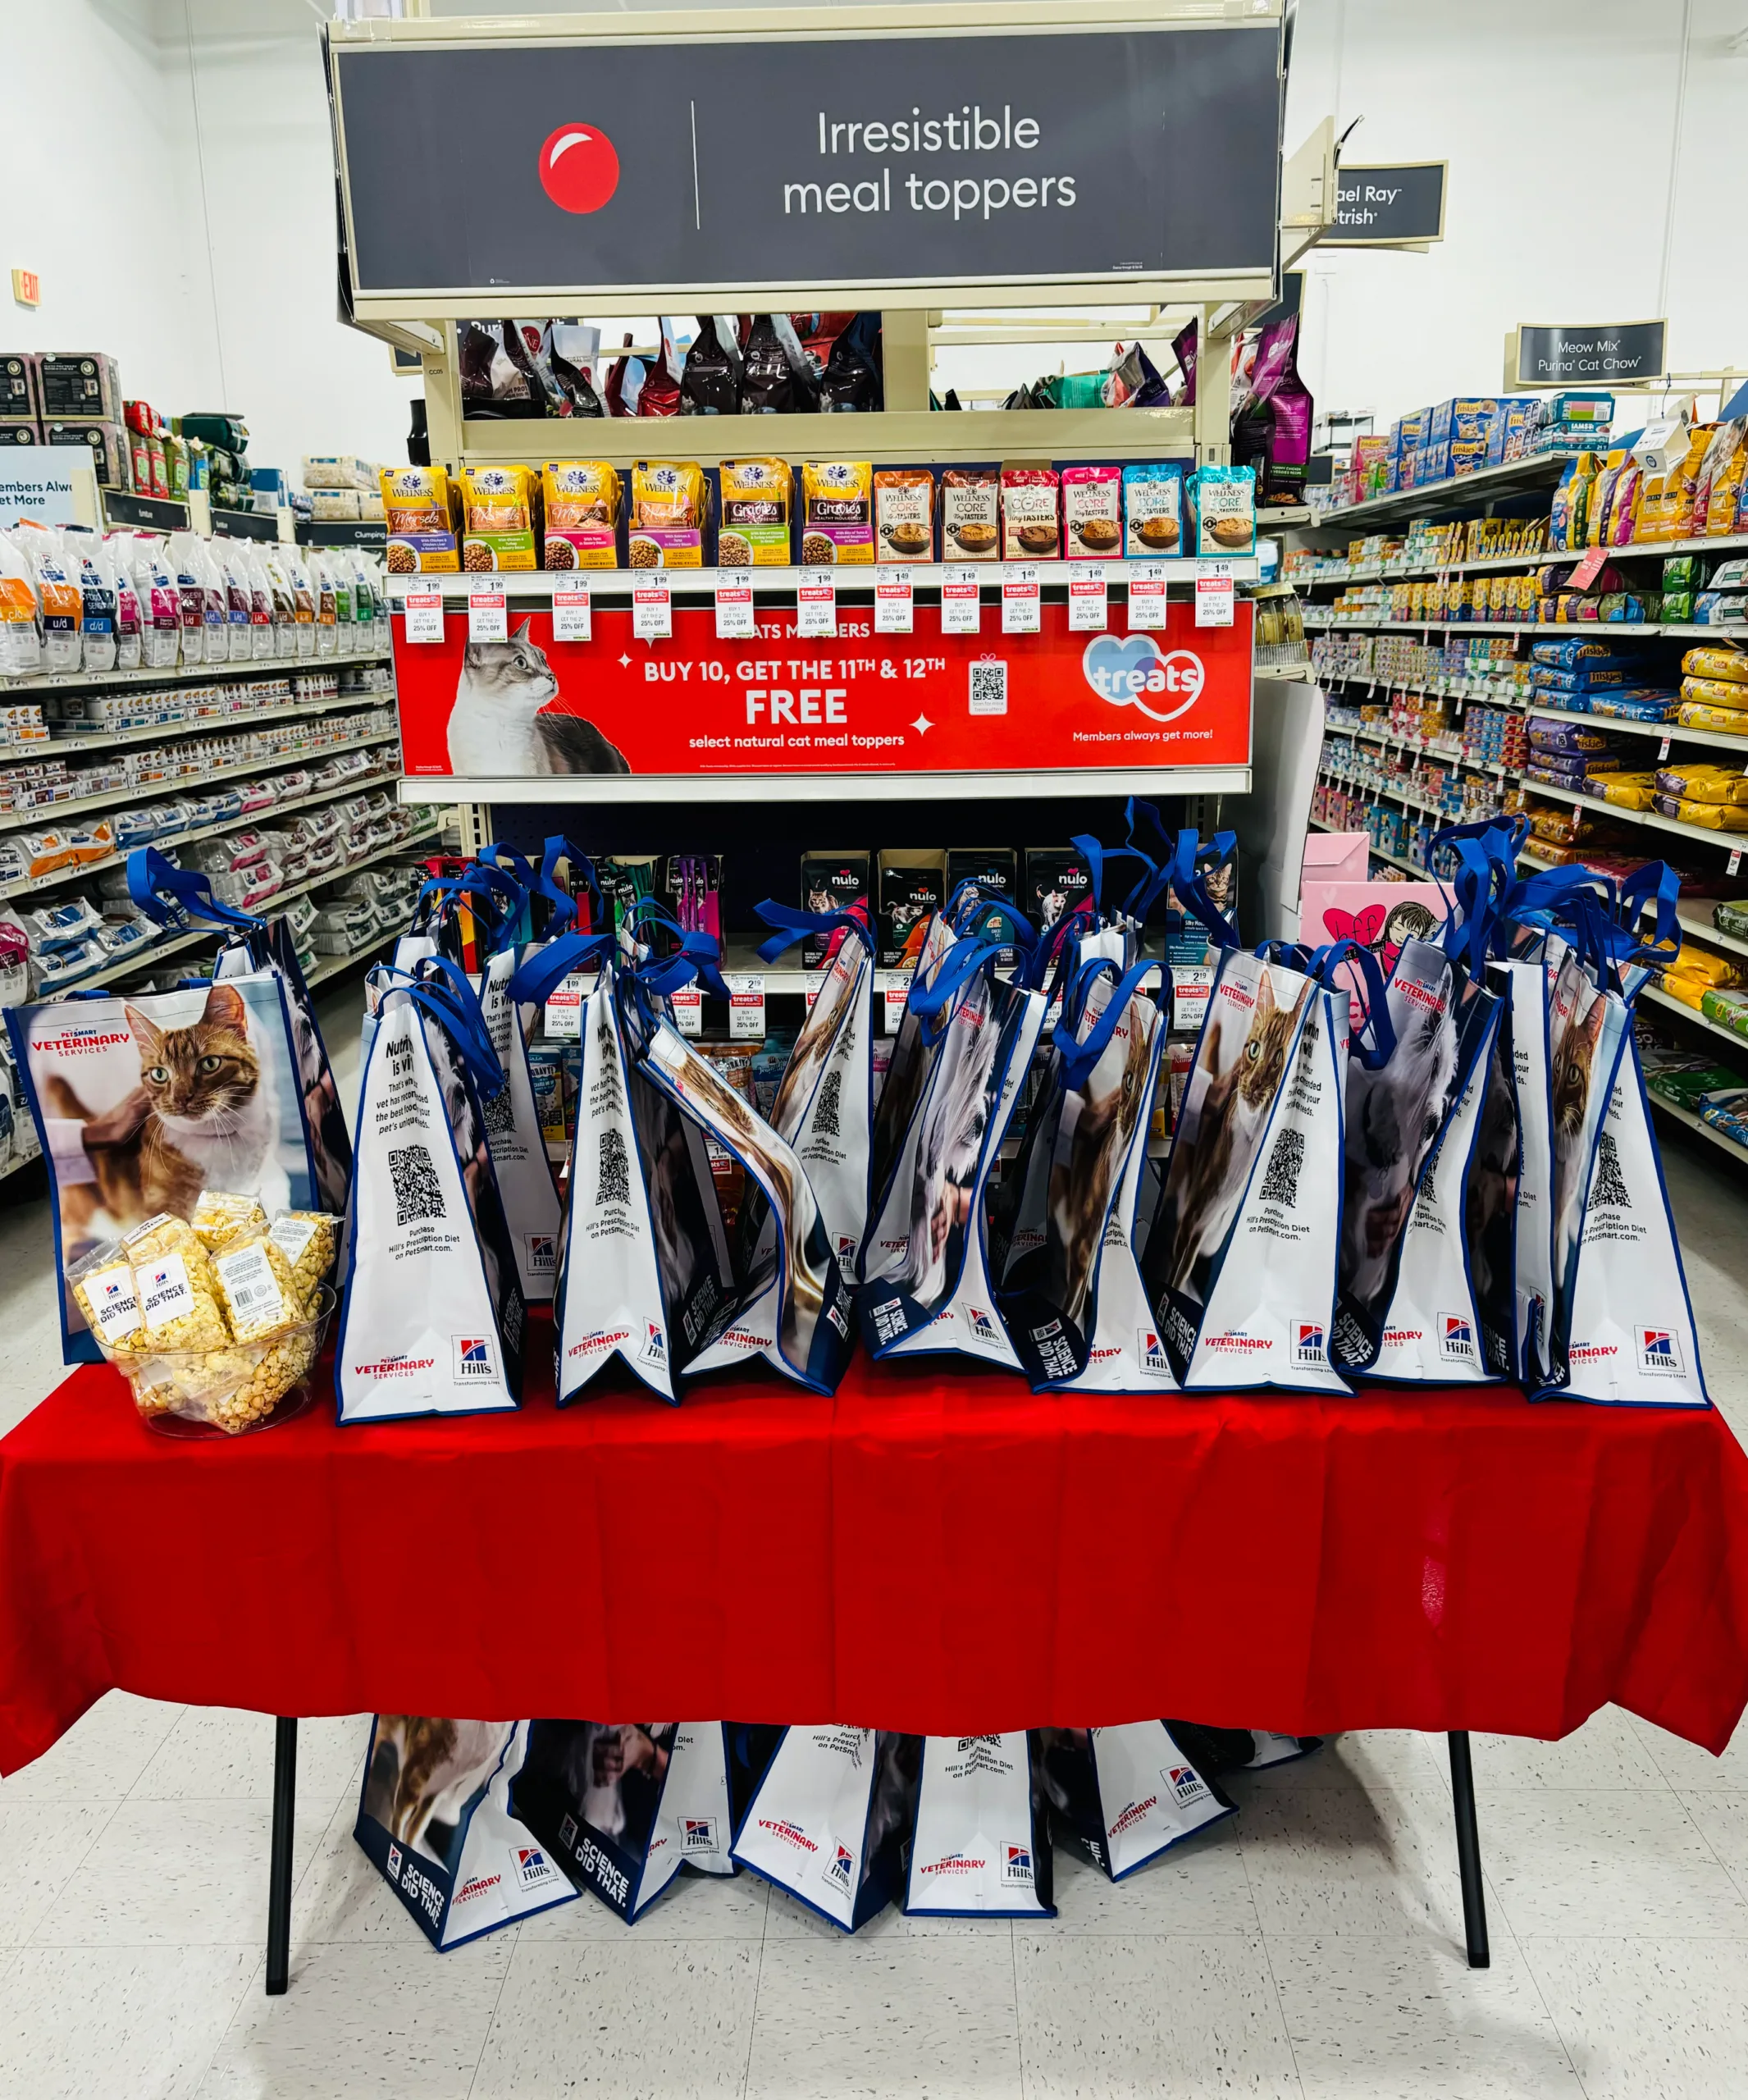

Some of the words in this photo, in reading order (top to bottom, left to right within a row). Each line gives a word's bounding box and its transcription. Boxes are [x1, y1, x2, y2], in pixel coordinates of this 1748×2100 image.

[820, 107, 1040, 154] Irresistible
[784, 169, 891, 214] meal
[906, 172, 1076, 221] toppers
[1559, 340, 1594, 353] Meow
[1578, 358, 1600, 372] Cat
[473, 486, 515, 495] WELLNESS
[556, 484, 600, 494] WELLNESS
[646, 482, 687, 493] WELLNESS
[817, 480, 860, 488] WELLNESS
[15, 495, 45, 504] More
[392, 487, 433, 498] WELLNESS
[1073, 490, 1111, 498] WELLNESS
[889, 502, 919, 511] CORE
[956, 503, 986, 512] CORE
[355, 532, 386, 540] Clumping
[52, 618, 67, 628] u/d
[89, 621, 103, 632] d/d
[645, 662, 693, 682] BUY
[699, 662, 731, 684] 10,
[736, 661, 782, 680] GET
[787, 660, 833, 679] THE
[838, 659, 875, 678] 11TH
[879, 660, 898, 678] &
[903, 657, 946, 678] 12TH
[1093, 665, 1199, 693] treats
[746, 688, 847, 724] FREE
[689, 735, 731, 748] select
[734, 735, 784, 747] natural
[787, 735, 810, 746] cat
[815, 733, 847, 746] meal
[851, 733, 905, 749] toppers
[1073, 731, 1121, 742] Members
[1124, 731, 1160, 742] always
[1162, 732, 1180, 742] get
[1183, 730, 1213, 739] more!
[832, 874, 859, 886] nulo
[978, 873, 1006, 883] nulo
[1059, 874, 1088, 884] nulo
[618, 883, 633, 893] nulo
[910, 891, 937, 901] nulo
[1416, 979, 1436, 993] PETSMART
[1220, 984, 1255, 1008] VETERINARY
[1394, 977, 1446, 1014] VETERINARY
[1227, 998, 1245, 1012] SERVICES
[1404, 995, 1431, 1014] SERVICES
[61, 1029, 98, 1038] PETSMART
[32, 1034, 130, 1051] VETERINARY
[59, 1045, 107, 1057] SERVICES
[377, 1097, 388, 1109] vet
[376, 1113, 388, 1121] the
[390, 1110, 403, 1120] best
[379, 1121, 397, 1135] pet's
[1594, 1212, 1621, 1223] Purchase
[409, 1226, 435, 1237] Purchase
[1292, 1225, 1310, 1233] Diet
[1631, 1225, 1647, 1235] Diet
[389, 1242, 404, 1253] Hill's
[406, 1235, 442, 1249] Prescription
[445, 1235, 460, 1243] Diet
[1587, 1232, 1641, 1244] PetSmart.com.
[395, 1252, 404, 1260] on
[405, 1244, 453, 1258] PetSmart.com.
[145, 1300, 160, 1311] DID
[162, 1289, 187, 1302] THAT.
[147, 1284, 184, 1304] SCIENCE
[974, 1326, 999, 1341] Hill's
[1339, 1312, 1374, 1360] SCIENCE
[568, 1332, 630, 1358] VETERINARY
[1037, 1342, 1052, 1358] DID
[1205, 1337, 1273, 1349] VETERINARY
[1445, 1342, 1474, 1356] Hill's
[381, 1355, 408, 1363] PETSMART
[1053, 1335, 1078, 1376] SCIENCE
[1645, 1354, 1677, 1368] Hill's
[355, 1359, 434, 1375] VETERINARY
[461, 1363, 491, 1374] Hill's
[374, 1371, 413, 1380] SERVICES
[1176, 1783, 1203, 1798] Hill's
[1107, 1796, 1157, 1838] VETERINARY
[687, 1834, 713, 1846] Hill's
[759, 1819, 819, 1852] VETERINARY
[582, 1838, 629, 1893] SCIENCE
[921, 1860, 985, 1874] VETERINARY
[523, 1865, 550, 1881] Hill's
[575, 1846, 596, 1873] DID
[597, 1871, 627, 1907] THAT.
[831, 1864, 849, 1887] Hill's
[1007, 1867, 1033, 1879] Hill's
[406, 1864, 445, 1912] SCIENCE
[401, 1873, 418, 1898] DID
[421, 1892, 440, 1928] THAT.
